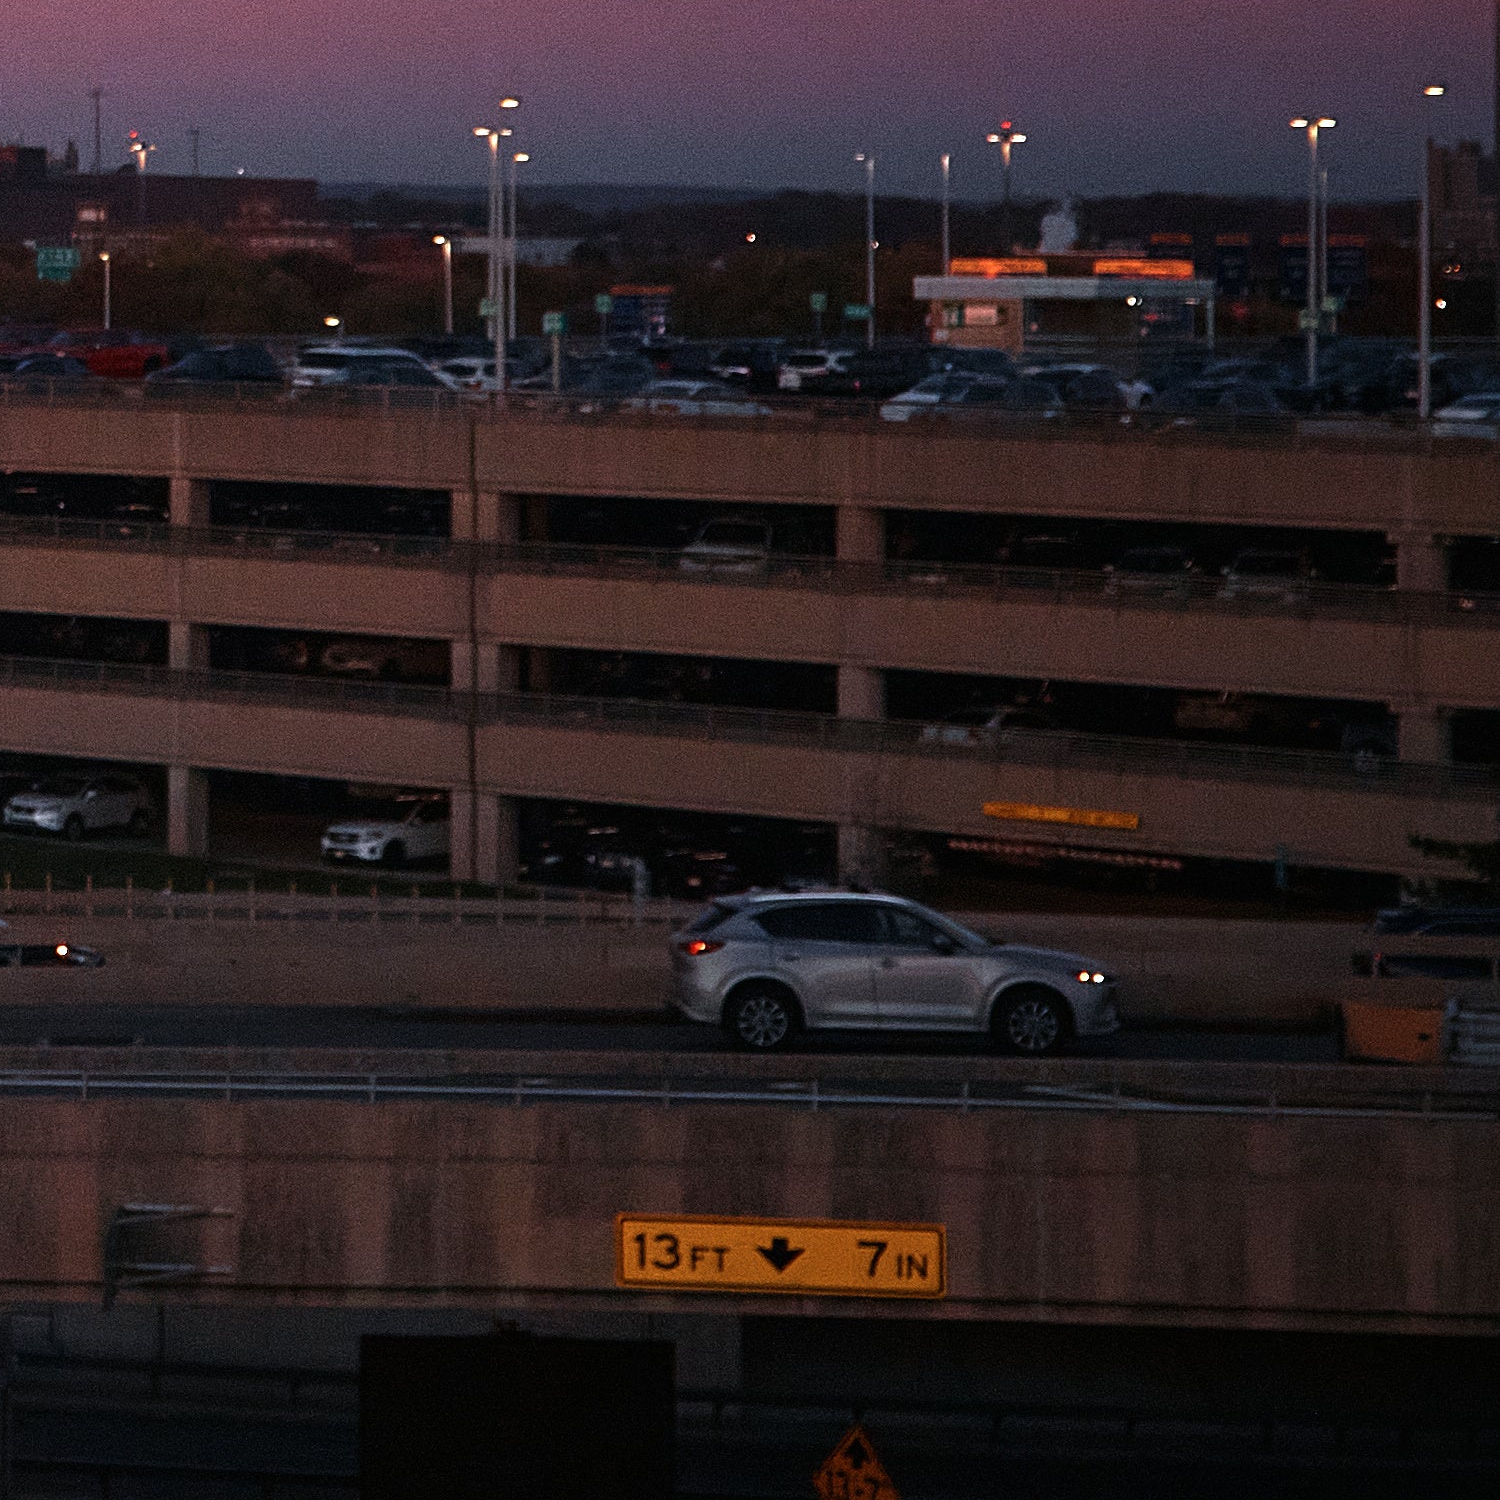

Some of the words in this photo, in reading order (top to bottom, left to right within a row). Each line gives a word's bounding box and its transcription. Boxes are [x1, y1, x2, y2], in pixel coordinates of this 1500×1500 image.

[633, 1232, 680, 1271] 13
[690, 1246, 731, 1272] FT
[857, 1240, 888, 1278] 7
[897, 1253, 928, 1279] IN
